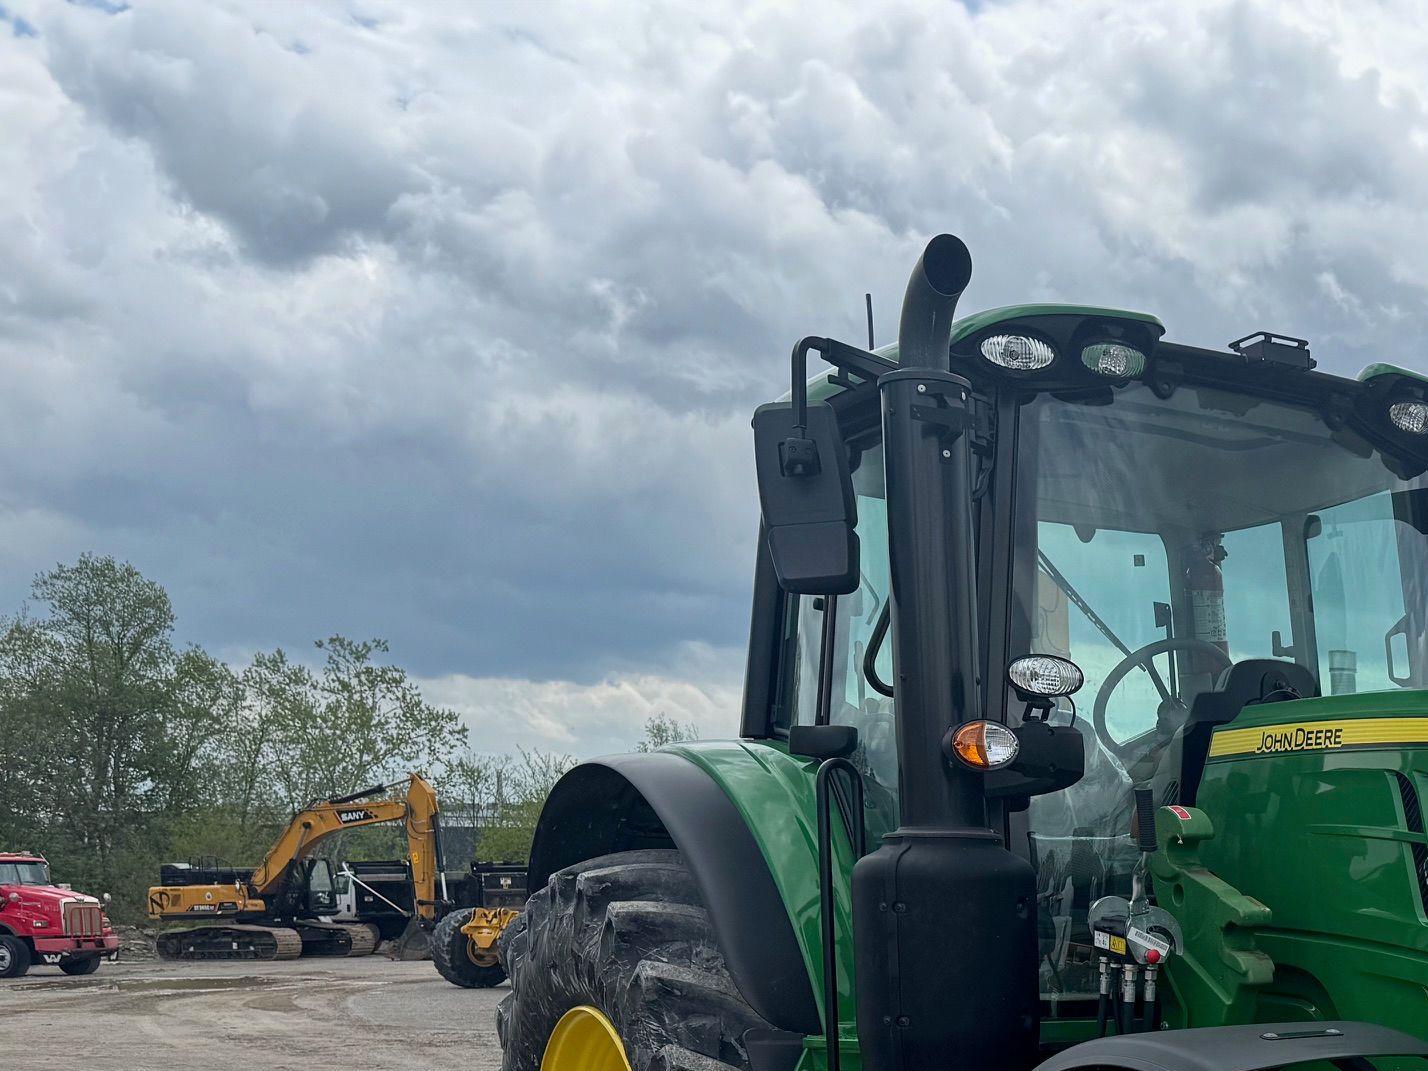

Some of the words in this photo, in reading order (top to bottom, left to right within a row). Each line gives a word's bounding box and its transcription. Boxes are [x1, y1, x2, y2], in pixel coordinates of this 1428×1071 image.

[1256, 731, 1293, 751] JOHN
[1294, 728, 1343, 748] DEERE
[341, 811, 365, 821] SANY
